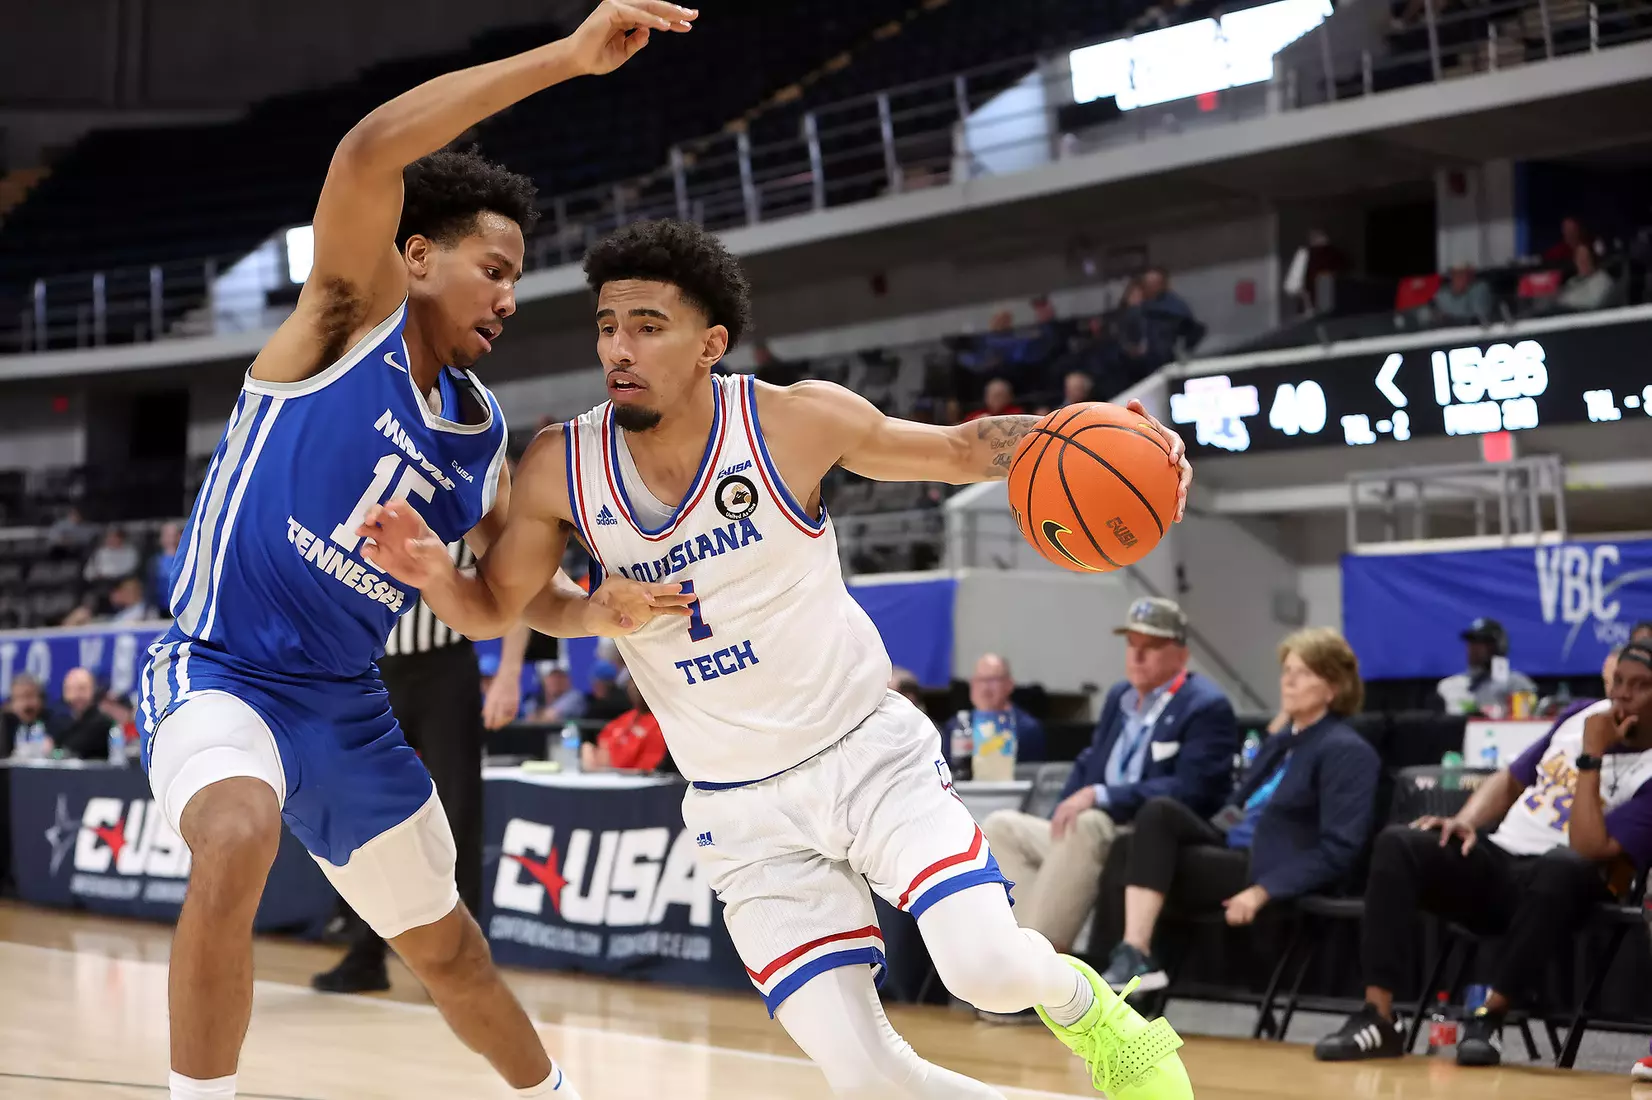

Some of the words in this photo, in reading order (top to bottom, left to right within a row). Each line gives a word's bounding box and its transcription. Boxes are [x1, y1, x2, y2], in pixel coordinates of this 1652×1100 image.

[287, 515, 405, 613] TENNESSEE
[1534, 544, 1620, 624] VBC
[678, 579, 713, 642] 1
[675, 640, 759, 685] TECH
